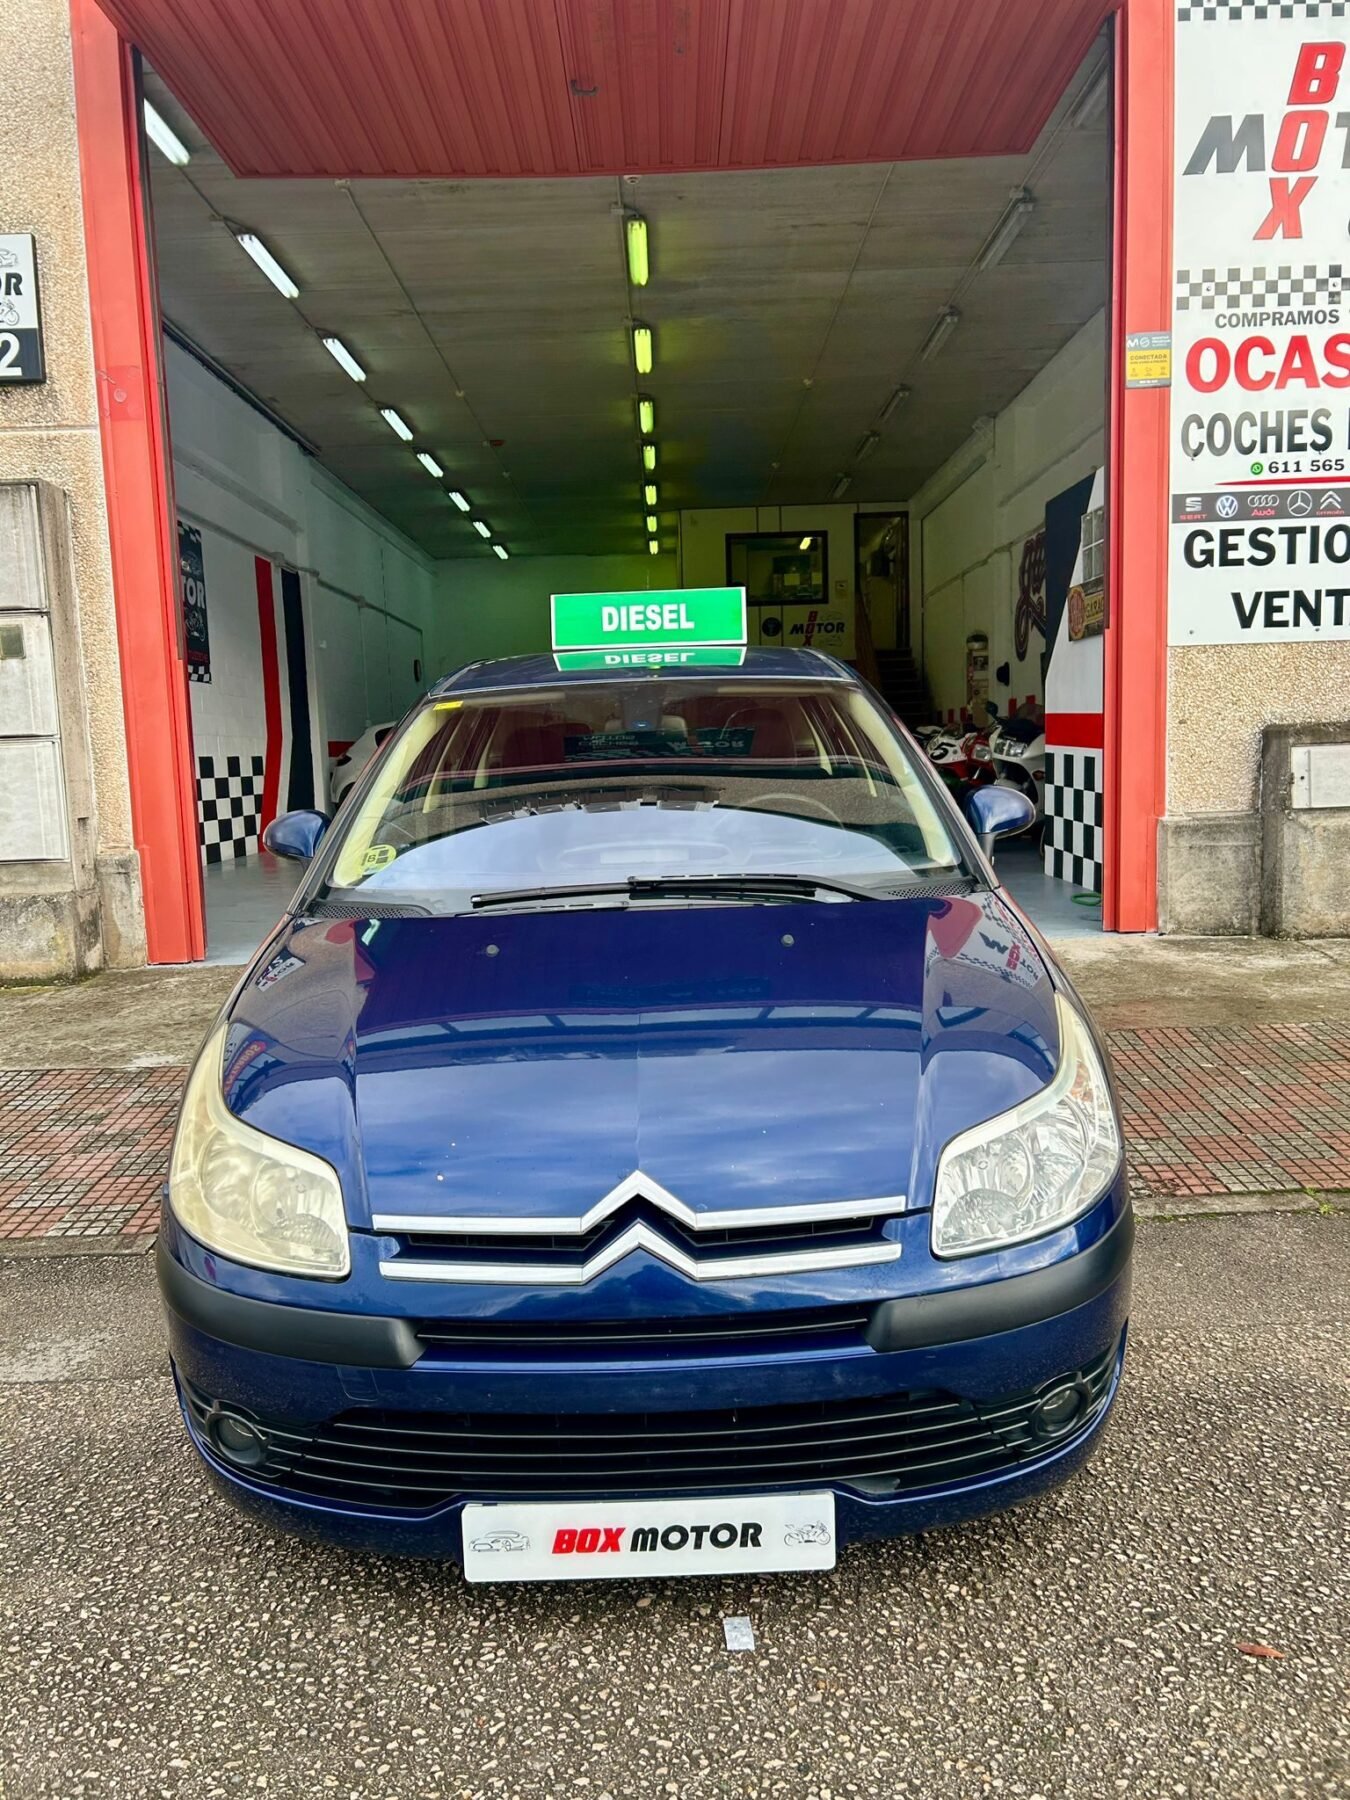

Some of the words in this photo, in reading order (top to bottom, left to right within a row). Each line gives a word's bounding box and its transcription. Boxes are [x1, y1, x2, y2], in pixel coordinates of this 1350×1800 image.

[1253, 41, 1346, 240] BOX
[1215, 309, 1340, 328] COMPRAMOS
[1185, 333, 1350, 393] OCAS
[1181, 408, 1333, 457] COCHES
[1268, 461, 1302, 474] 611
[1310, 459, 1345, 472] 565
[1251, 508, 1276, 517] Audi
[1184, 524, 1350, 568] GESTIO
[601, 603, 695, 632] DIESEL
[789, 622, 845, 635] MOTOR
[551, 1527, 626, 1554] BOX
[629, 1522, 763, 1552] MOTOR
